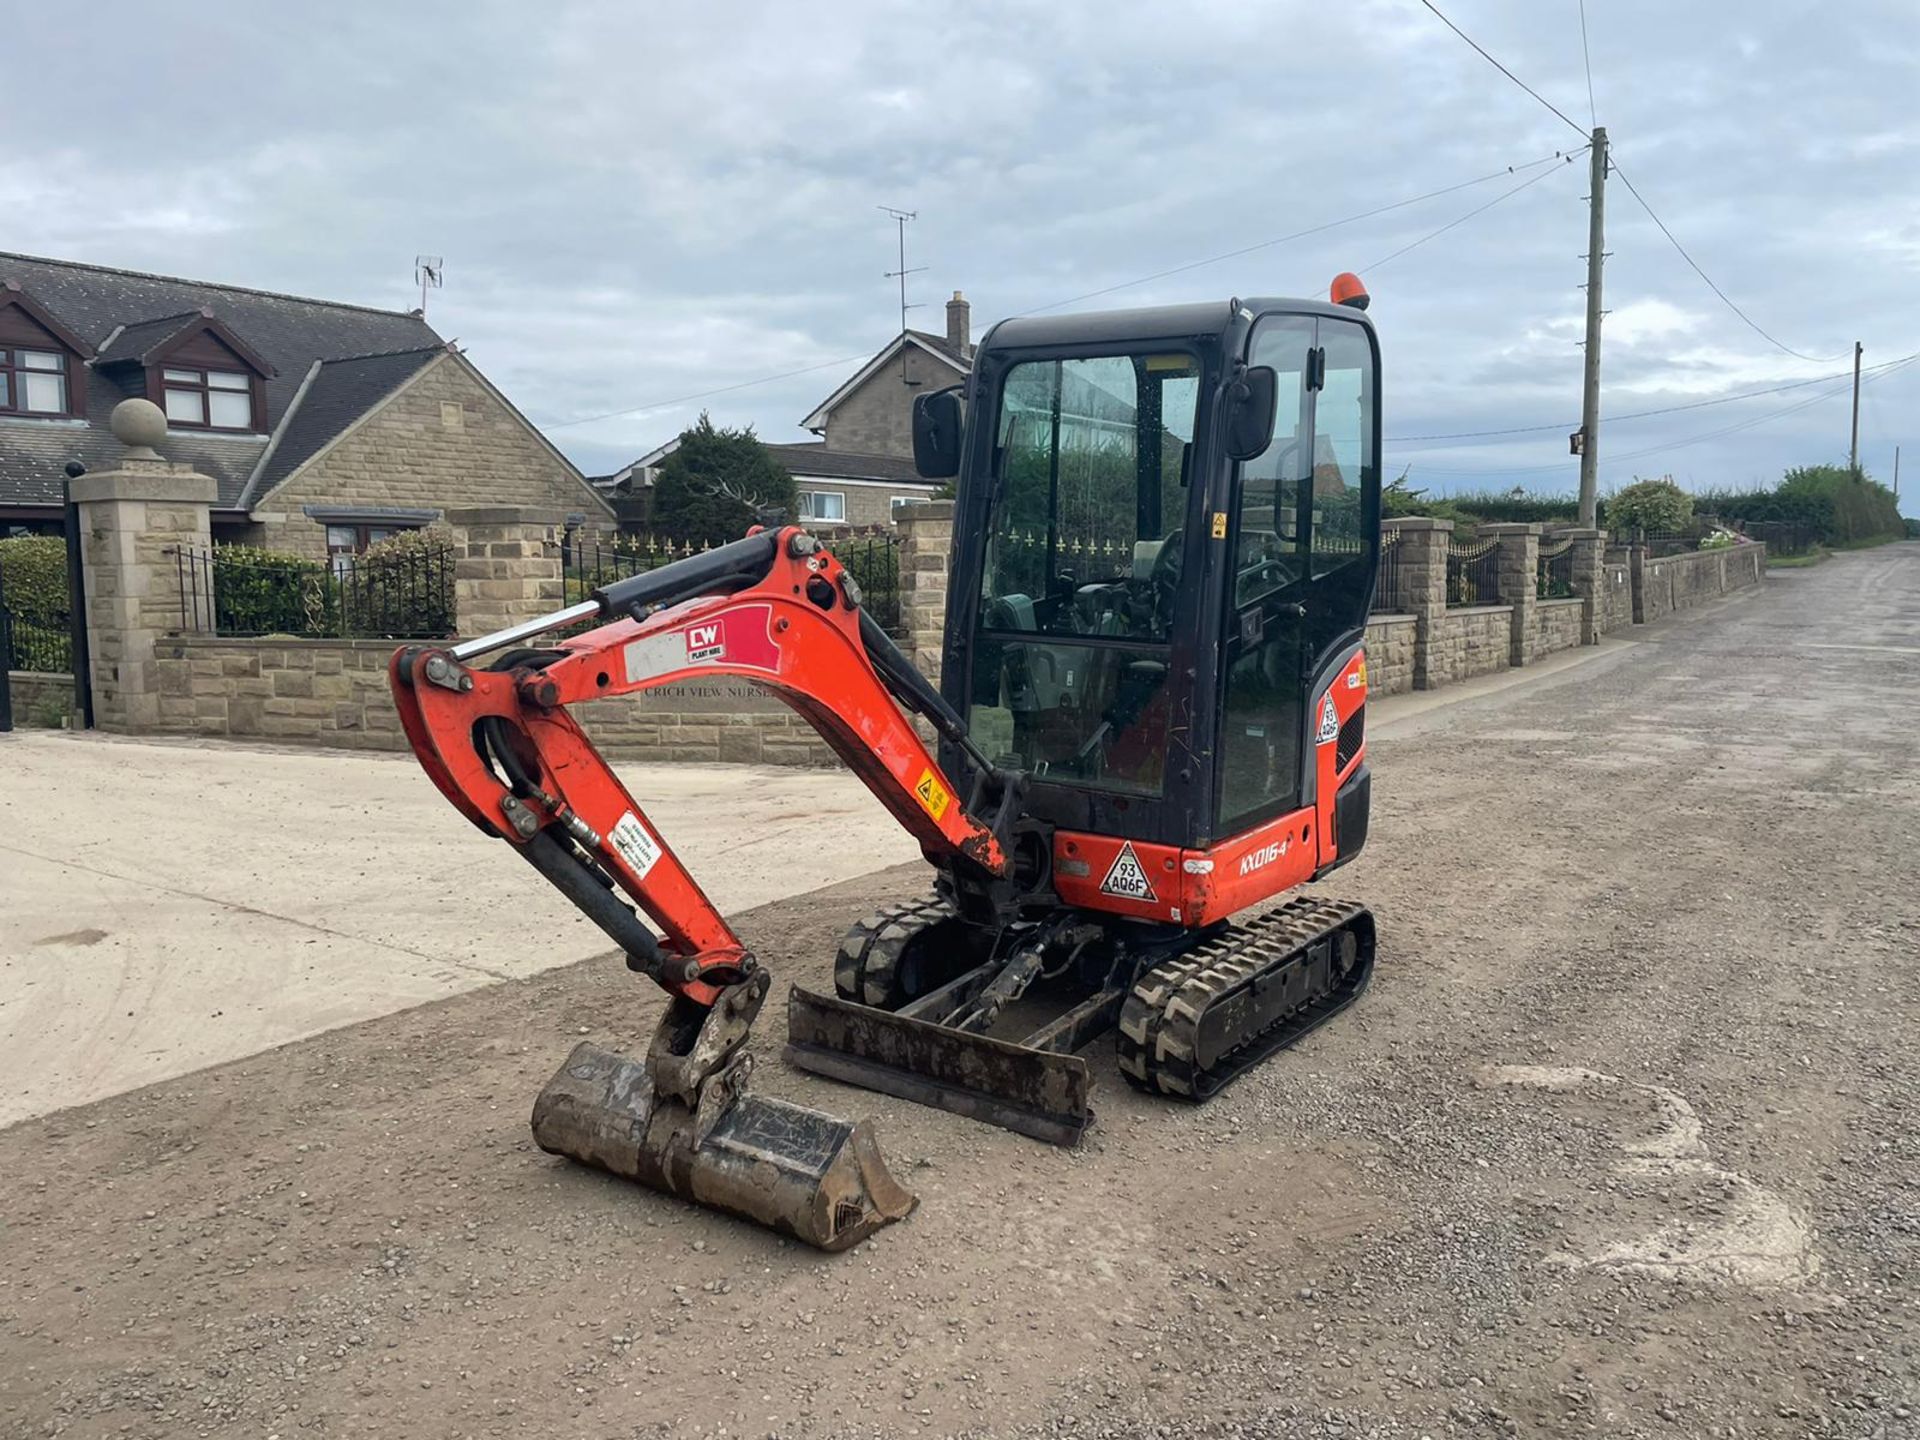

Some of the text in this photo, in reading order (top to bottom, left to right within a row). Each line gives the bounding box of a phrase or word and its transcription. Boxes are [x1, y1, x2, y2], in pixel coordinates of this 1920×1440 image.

[690, 625, 718, 648] CW
[692, 650, 708, 660] PLANT
[644, 687, 776, 697] CRICH VIEW NURSE
[1326, 709, 1334, 722] 93
[1120, 863, 1136, 878] 93
[1112, 877, 1144, 893] AQ6F
